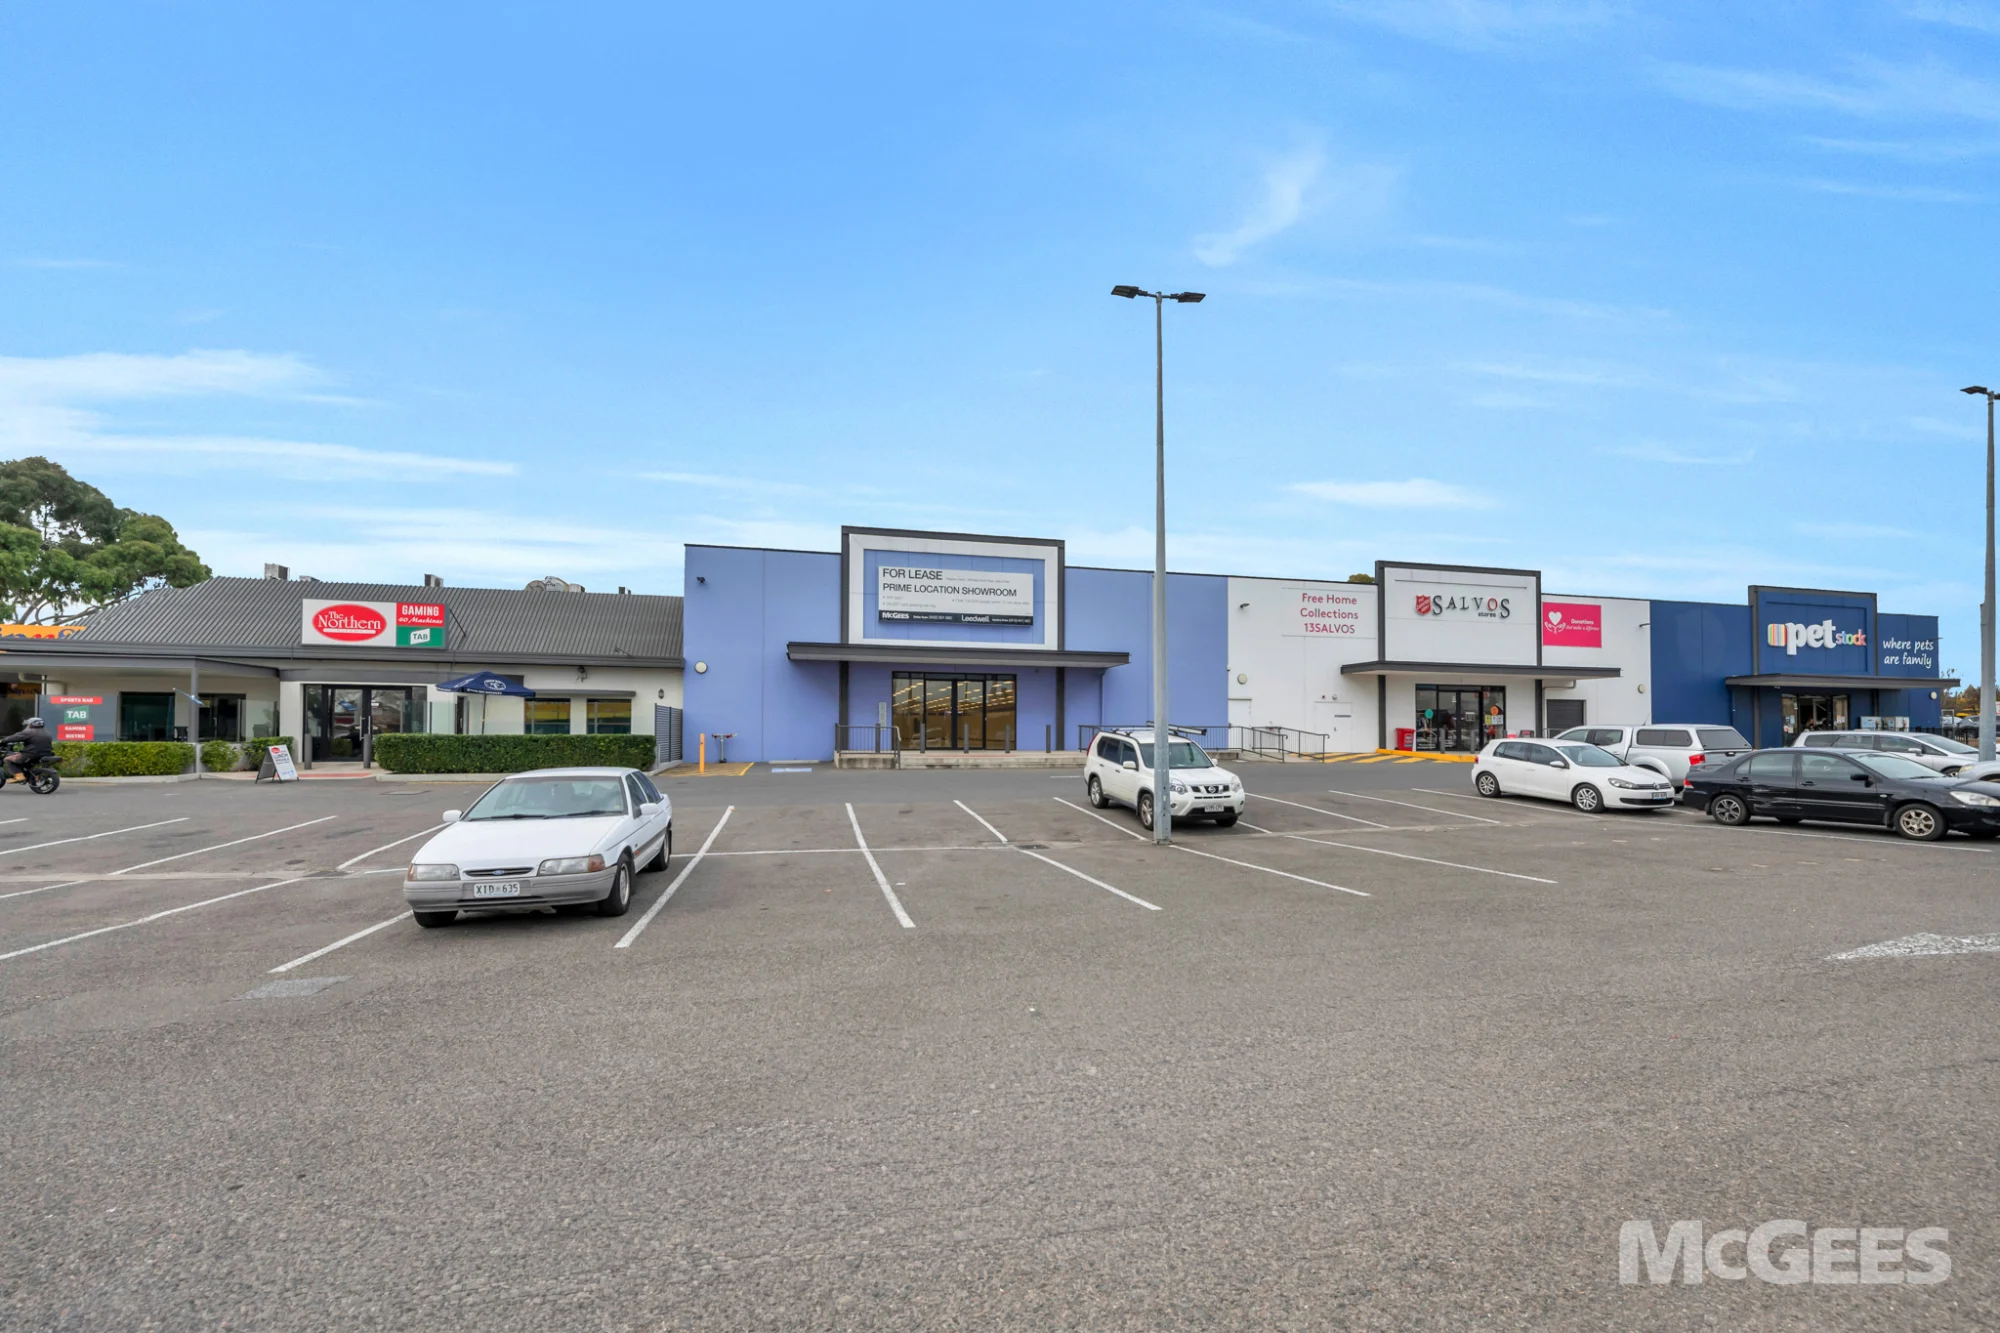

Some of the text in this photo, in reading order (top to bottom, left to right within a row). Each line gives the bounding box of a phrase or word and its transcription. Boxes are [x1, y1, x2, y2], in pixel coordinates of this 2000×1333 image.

[883, 568, 943, 580] FOR LEASE
[883, 583, 1017, 597] PRIME LOCATION SHOWROOM
[1302, 593, 1357, 605] Free Home
[402, 605, 439, 617] GAMING
[1432, 595, 1510, 618] SALVOS
[328, 611, 344, 620] The
[1300, 607, 1359, 619] Collections
[318, 614, 381, 630] Northern
[408, 616, 443, 624] Machines
[1304, 622, 1355, 634] 13SALVOS
[1882, 637, 1934, 653] where pets
[1884, 653, 1932, 669] are family
[66, 710, 87, 719] TAB
[502, 883, 518, 893] 635
